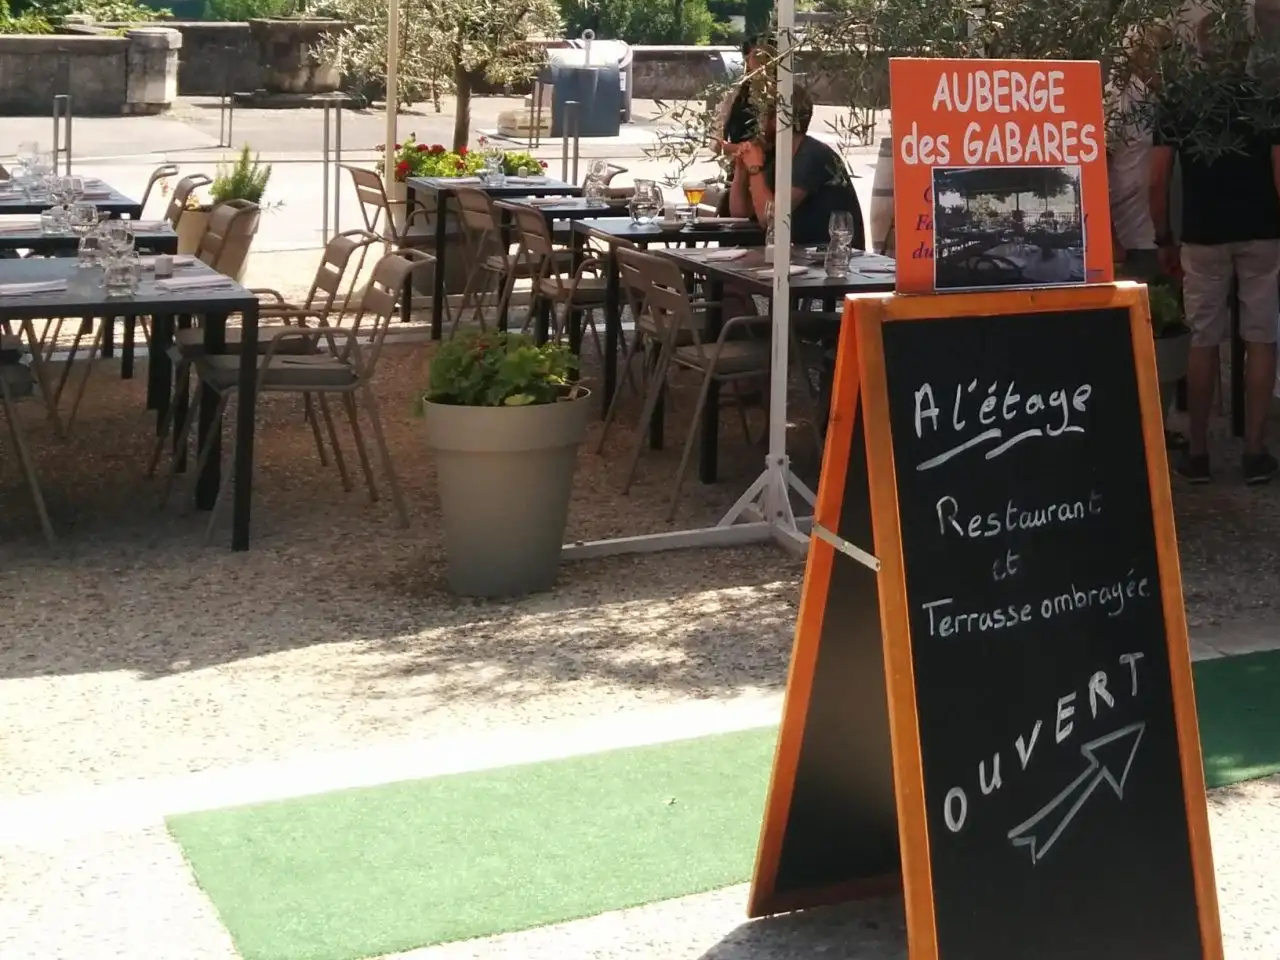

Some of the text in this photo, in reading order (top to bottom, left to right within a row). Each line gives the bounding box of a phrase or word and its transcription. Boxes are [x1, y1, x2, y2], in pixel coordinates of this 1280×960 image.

[932, 70, 1065, 113] AUBERGE
[901, 121, 1098, 165] des GABARES
[914, 378, 1092, 438] A l'étage
[936, 490, 1102, 537] Restaurant
[992, 549, 1021, 581] et
[922, 597, 1032, 637] Terrasse
[943, 651, 1145, 832] OUVERT
